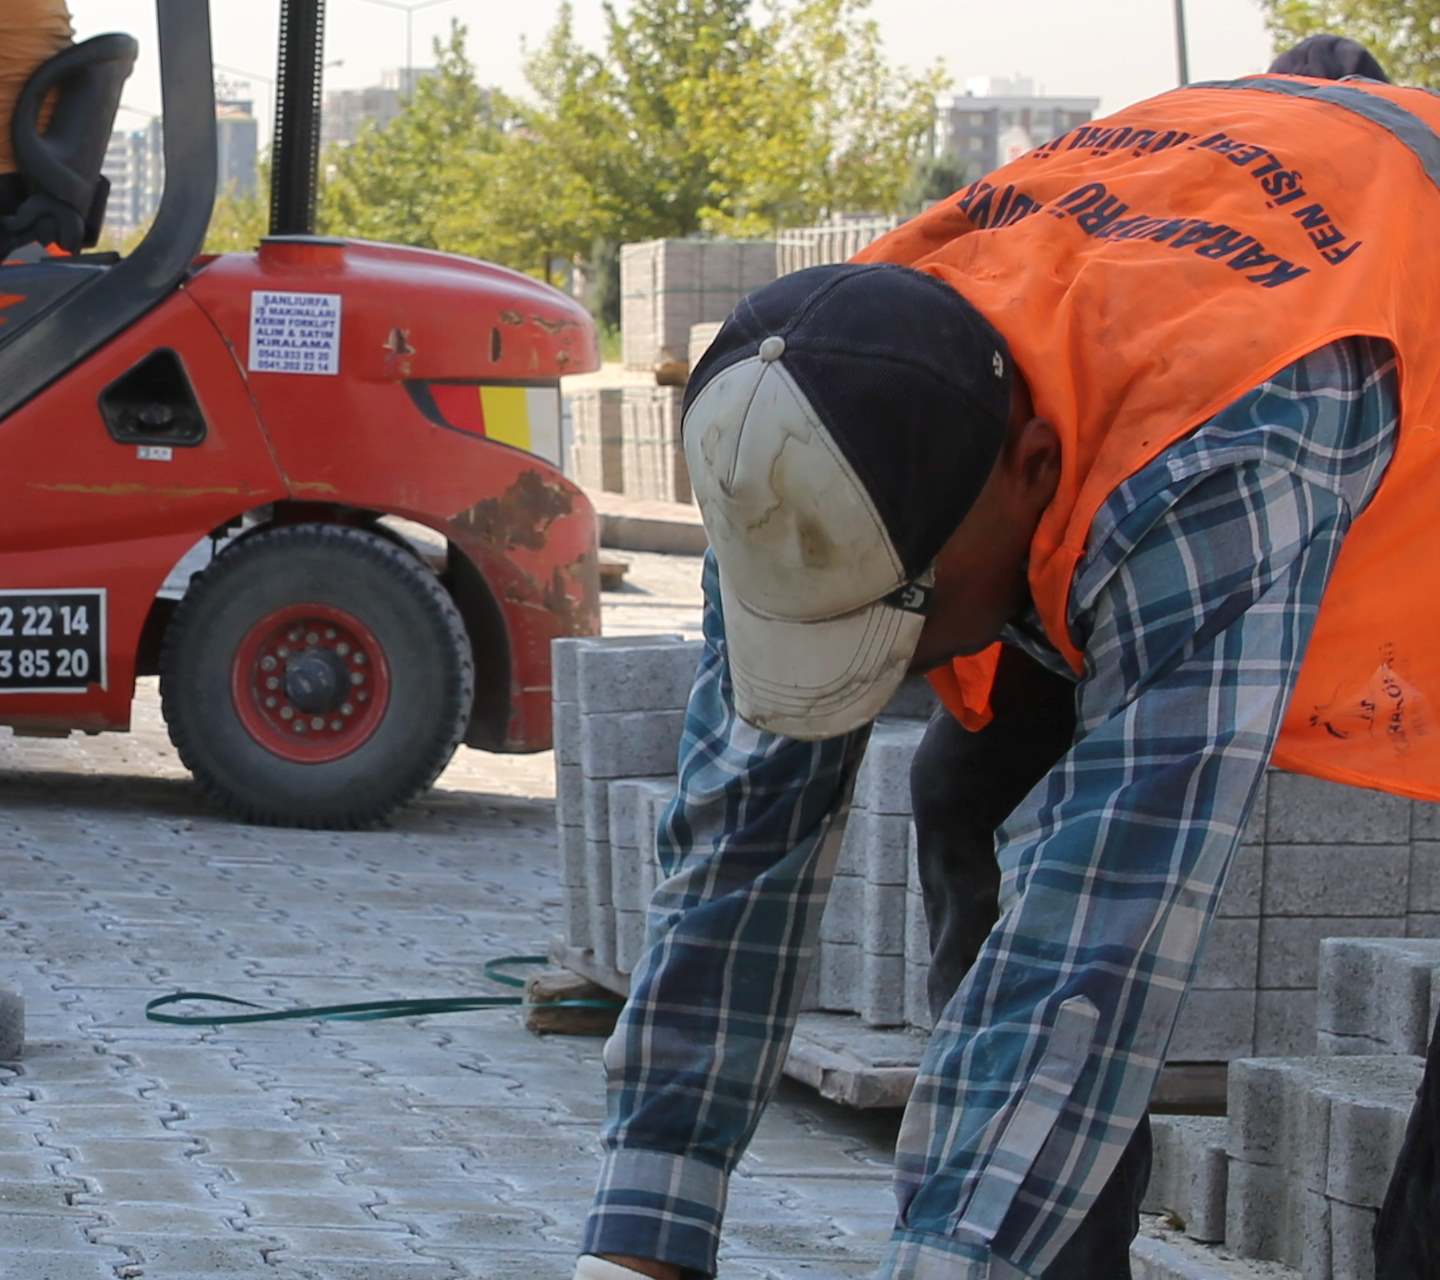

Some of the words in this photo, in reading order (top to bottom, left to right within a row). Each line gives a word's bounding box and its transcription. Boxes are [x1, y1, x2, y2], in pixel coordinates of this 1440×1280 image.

[1291, 203, 1362, 266] FEN
[22, 605, 53, 636] 22
[60, 605, 89, 635] 14
[18, 649, 50, 677] 85
[56, 648, 89, 677] 20
